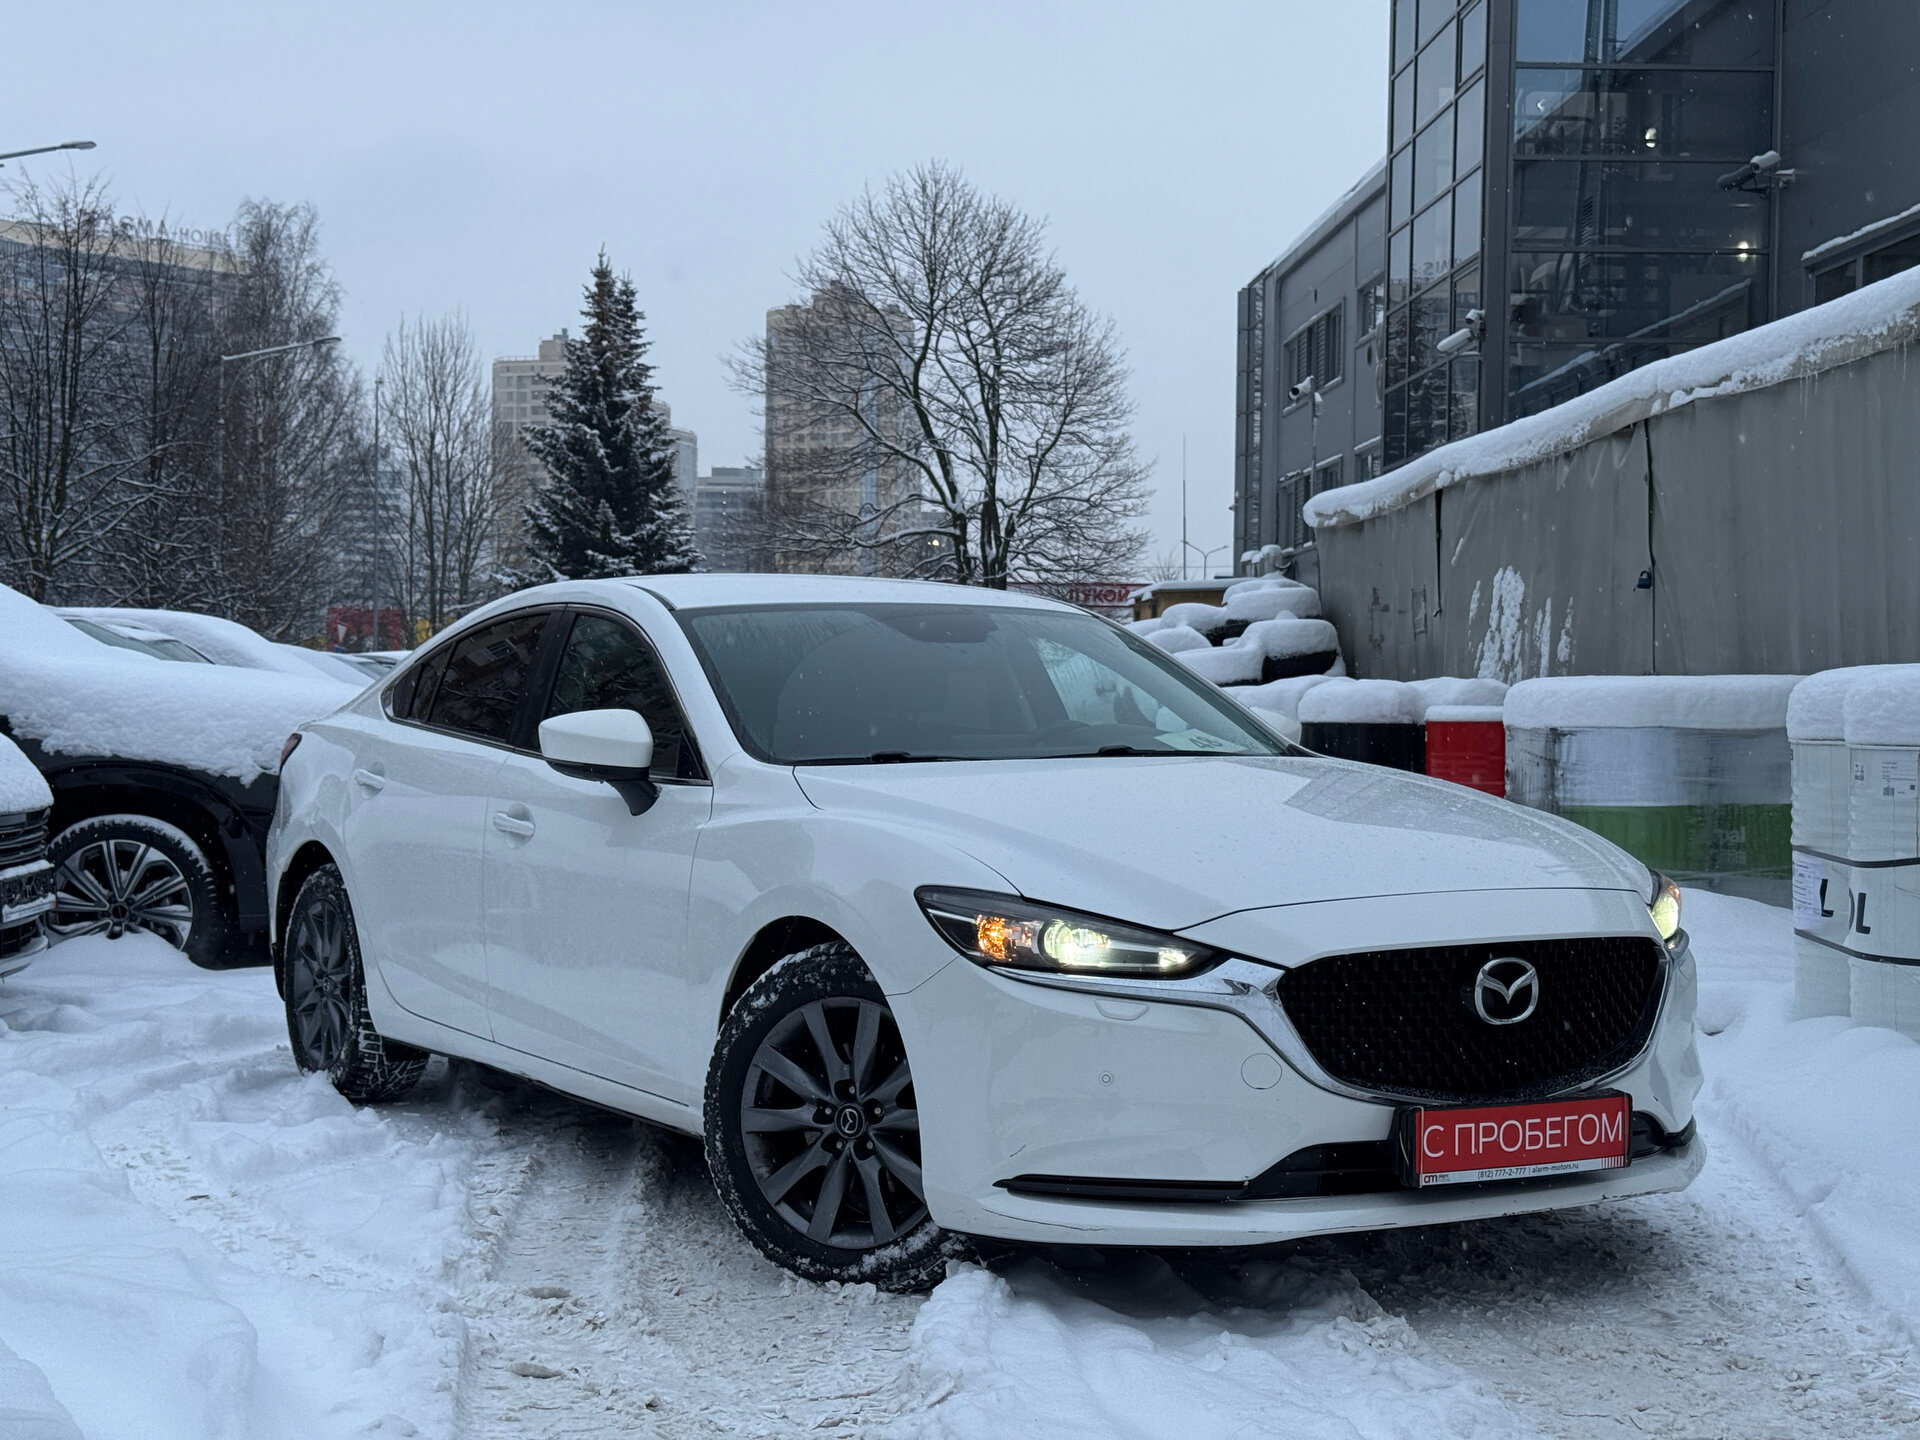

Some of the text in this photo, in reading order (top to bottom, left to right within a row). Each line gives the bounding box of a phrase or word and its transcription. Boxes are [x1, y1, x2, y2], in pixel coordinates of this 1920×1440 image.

[1423, 1111, 1623, 1158] С ПРОБЕГОМ
[1477, 1163, 1579, 1180] (812) 777-2-777 alarm-motors.ru
